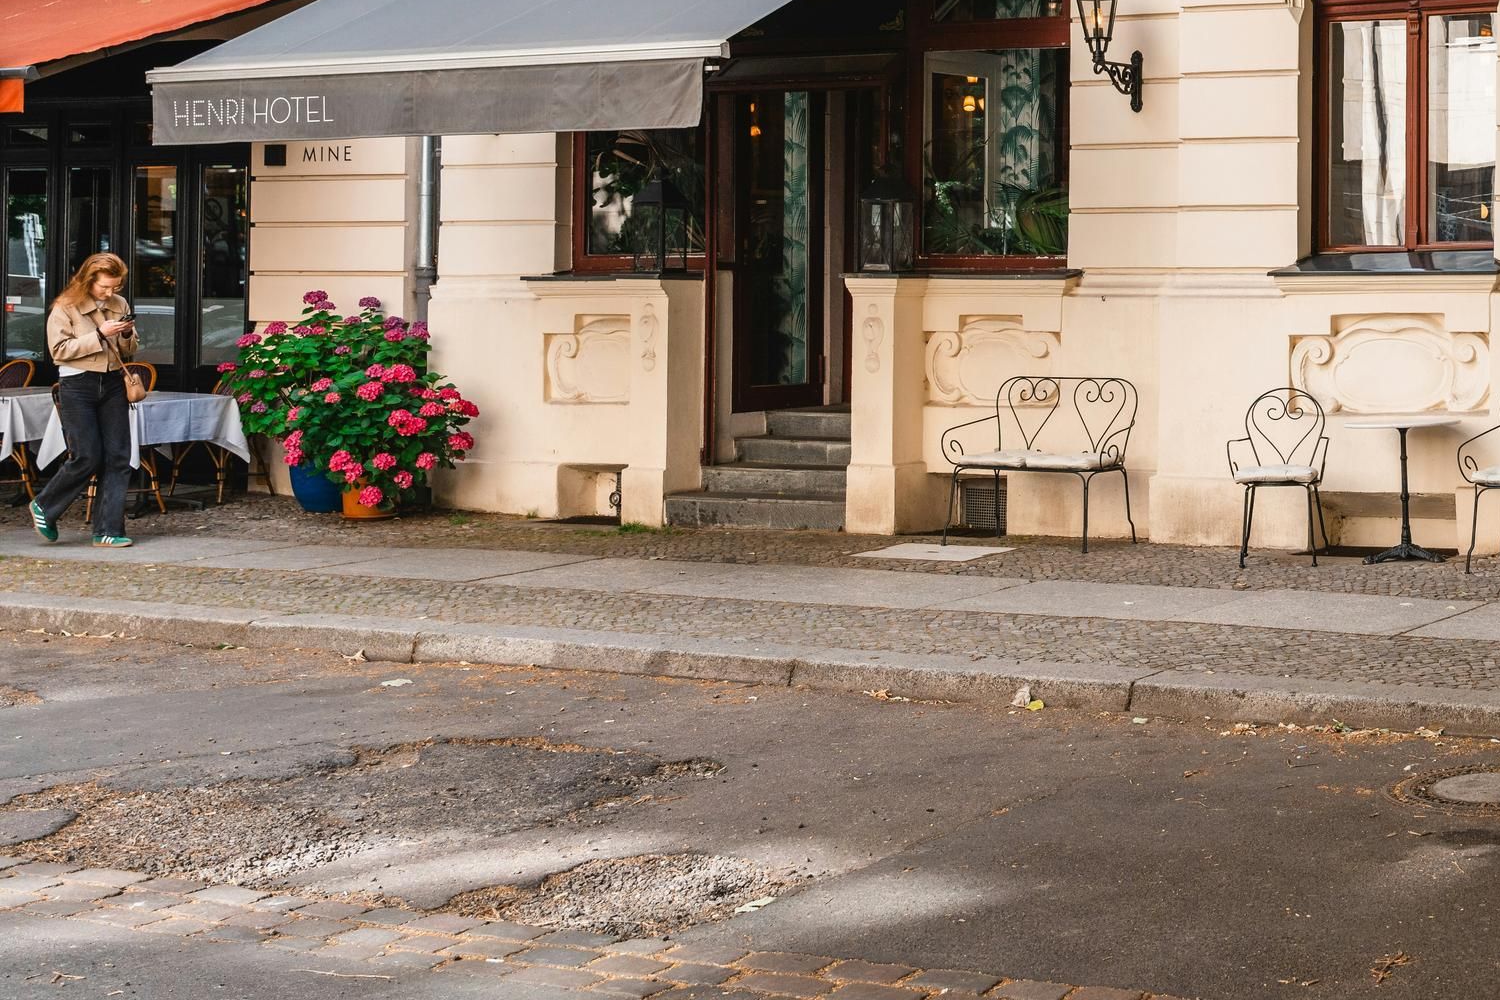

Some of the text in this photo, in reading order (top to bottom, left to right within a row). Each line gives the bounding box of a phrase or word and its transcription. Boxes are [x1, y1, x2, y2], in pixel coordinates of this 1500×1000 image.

[173, 96, 334, 127] HENRI HOTEL
[302, 145, 352, 162] MINE
